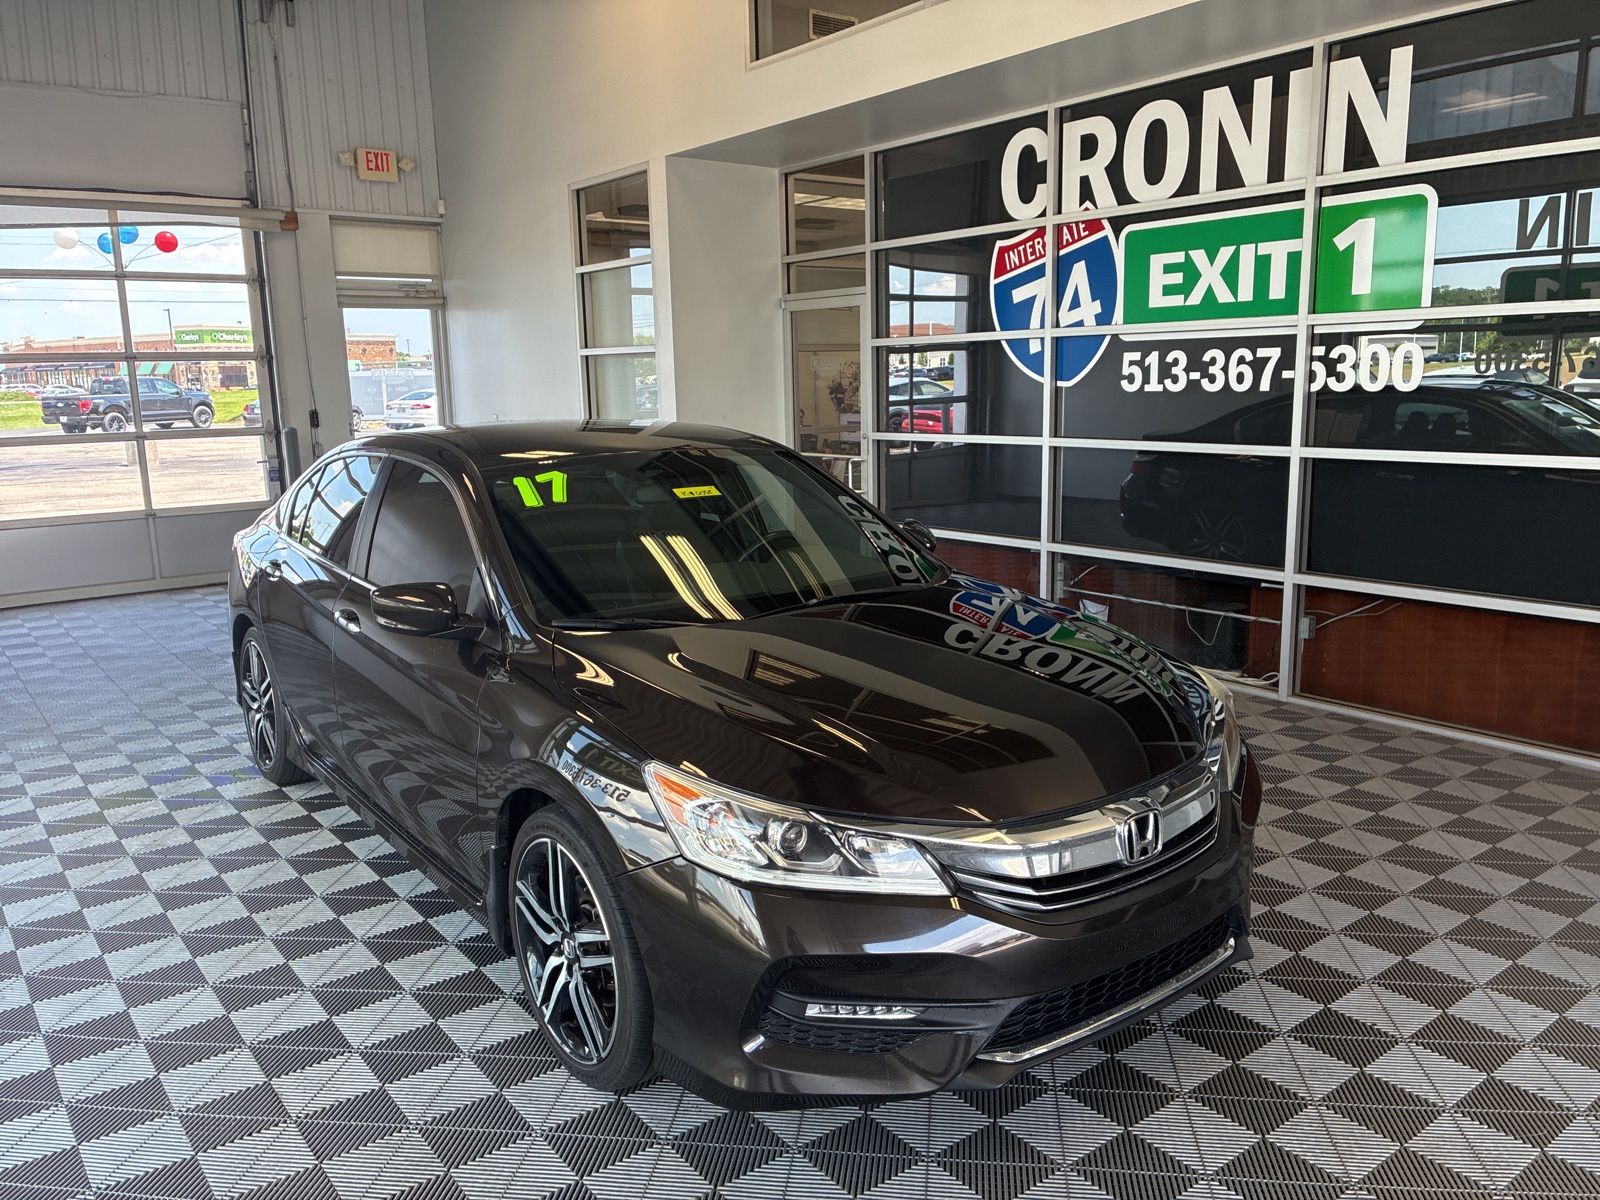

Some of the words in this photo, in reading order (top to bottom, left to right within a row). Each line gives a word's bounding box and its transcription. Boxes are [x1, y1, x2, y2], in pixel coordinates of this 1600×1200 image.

[1000, 45, 1413, 221] CRONIN
[365, 151, 391, 172] EXIT
[1004, 222, 1089, 271] INTERATE
[1149, 238, 1303, 308] EXIT
[1332, 217, 1376, 296] 1
[1011, 259, 1102, 355] 74
[1120, 342, 1424, 393] 513-367-5300
[513, 470, 568, 507] 17
